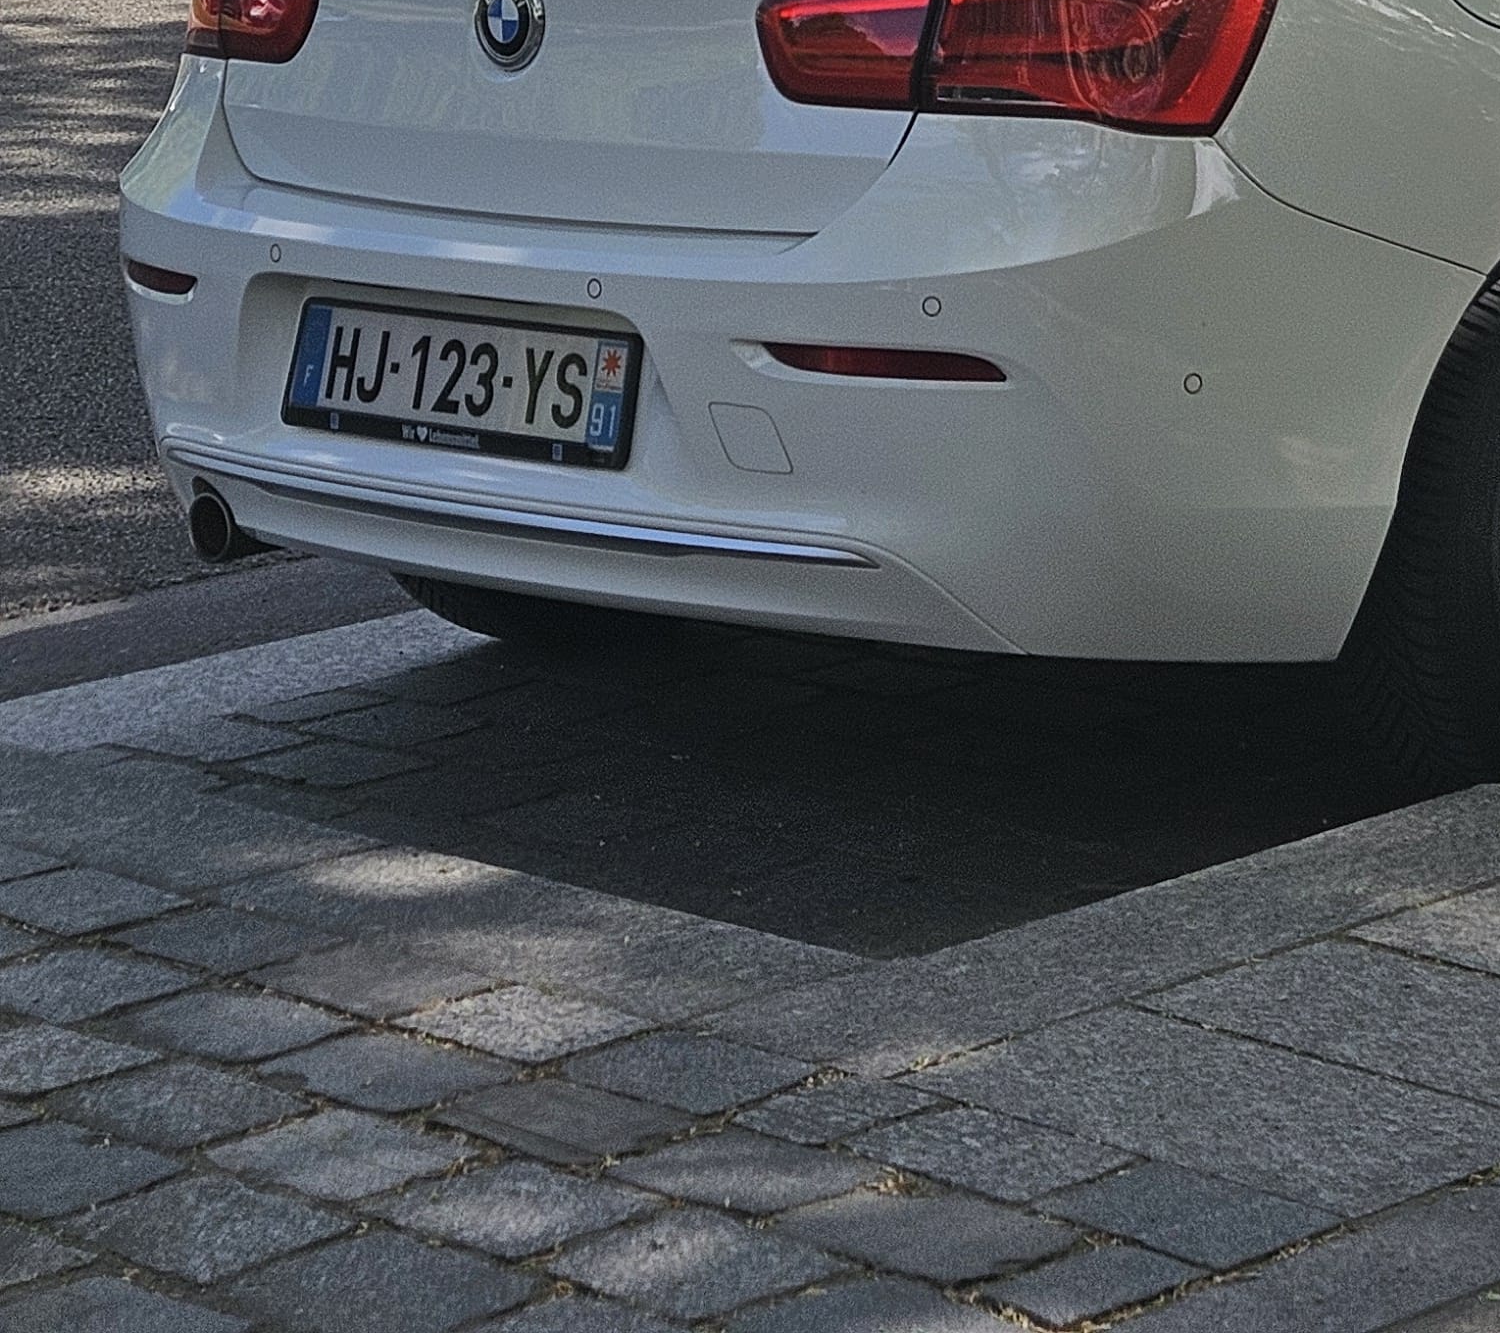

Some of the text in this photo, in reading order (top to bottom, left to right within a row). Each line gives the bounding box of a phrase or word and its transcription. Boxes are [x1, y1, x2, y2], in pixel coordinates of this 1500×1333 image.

[304, 364, 314, 388] F
[325, 325, 588, 430] HJ-123-YS
[589, 402, 617, 439] 91
